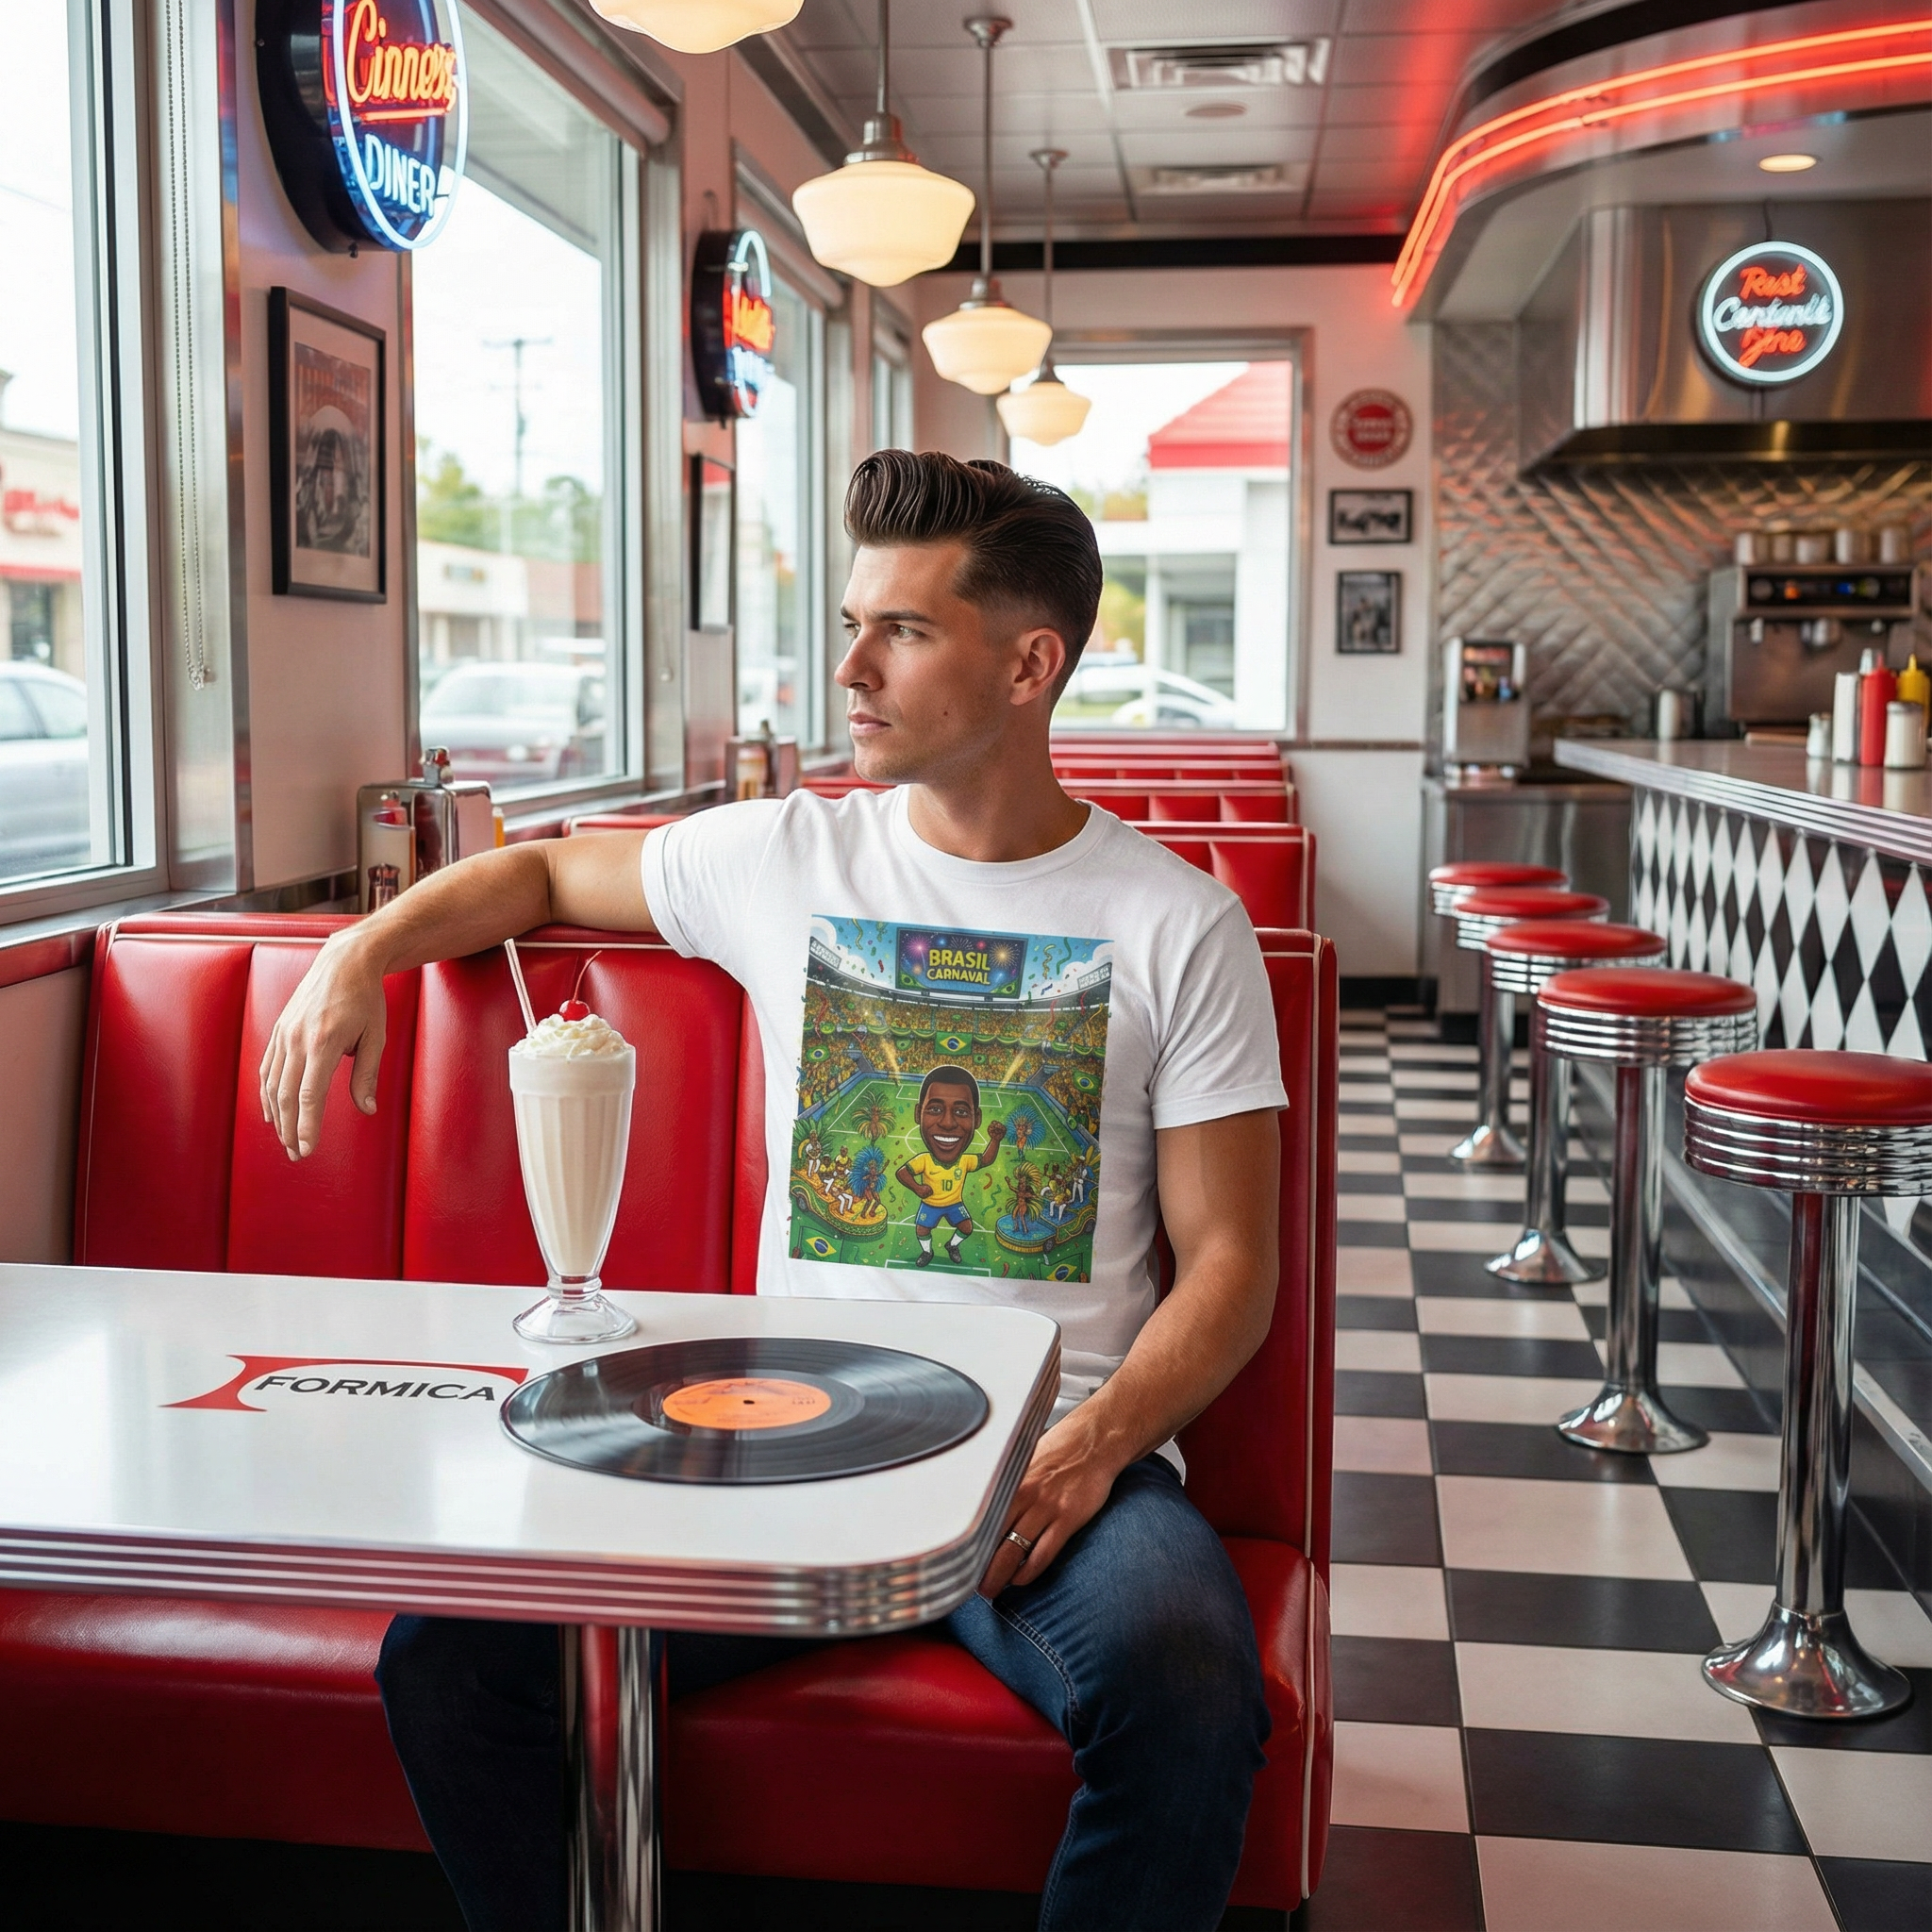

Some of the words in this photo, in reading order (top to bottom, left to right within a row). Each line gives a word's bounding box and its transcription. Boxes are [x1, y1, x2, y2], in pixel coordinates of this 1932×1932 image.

[364, 133, 435, 217] DINER
[929, 949, 991, 971] BRASIL
[926, 968, 991, 985] CARNAVAL
[941, 1179, 953, 1191] 10
[254, 1375, 495, 1401] FORMICA
